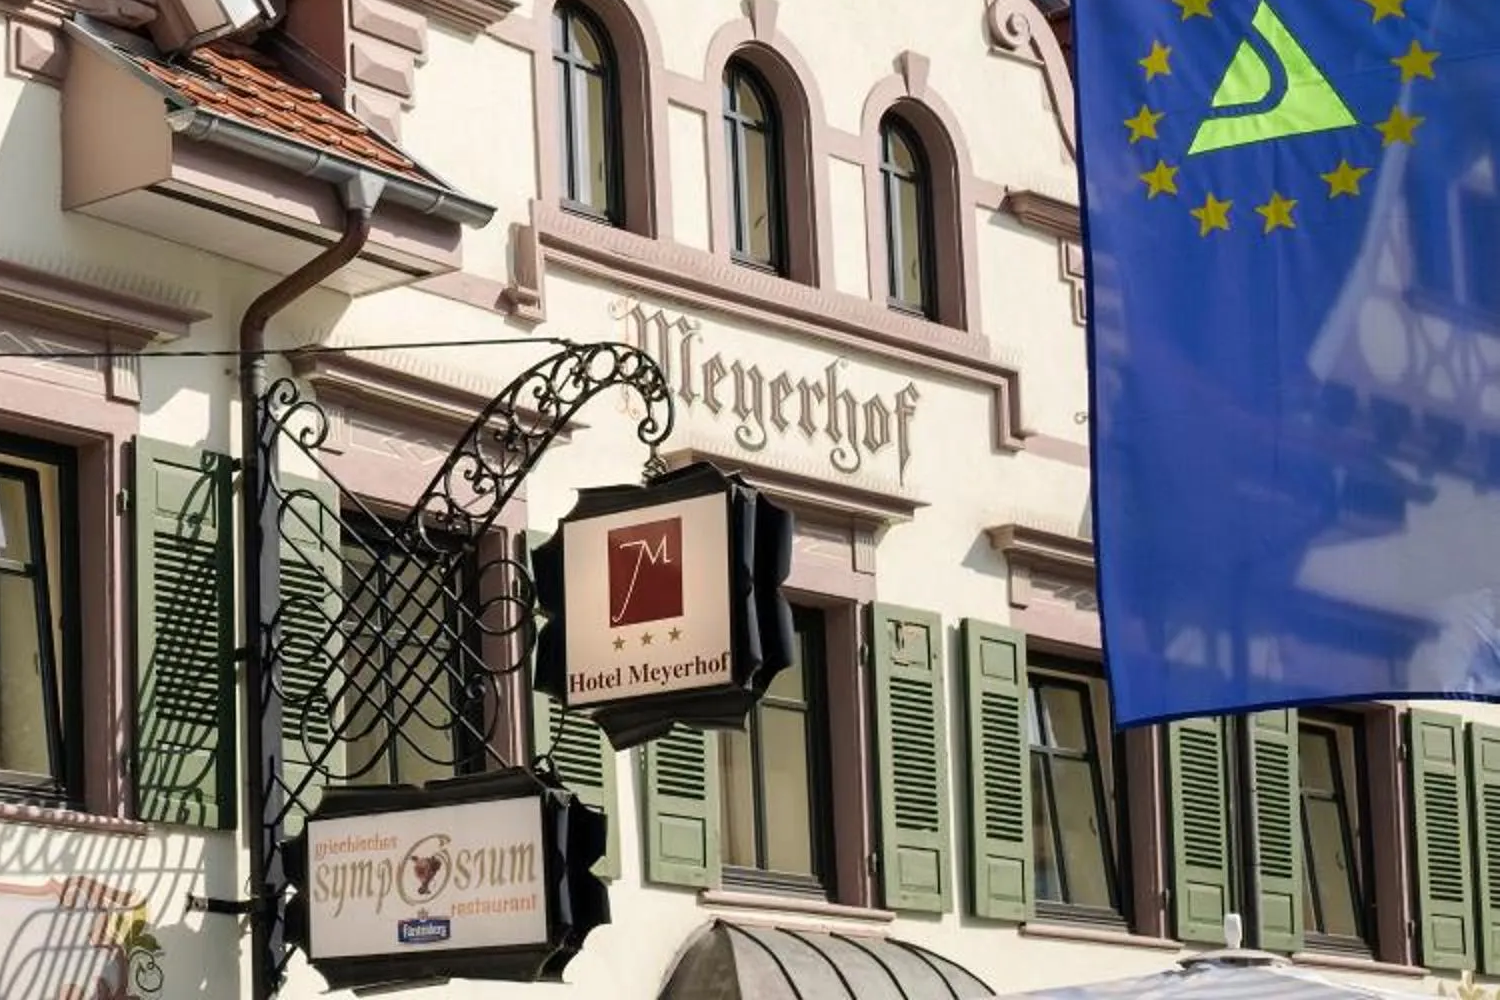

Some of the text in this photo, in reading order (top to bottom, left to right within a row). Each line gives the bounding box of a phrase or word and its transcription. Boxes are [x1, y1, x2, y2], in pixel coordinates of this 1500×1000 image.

[608, 298, 921, 488] Meyerhof
[569, 651, 730, 693] Hotel Meyerhof
